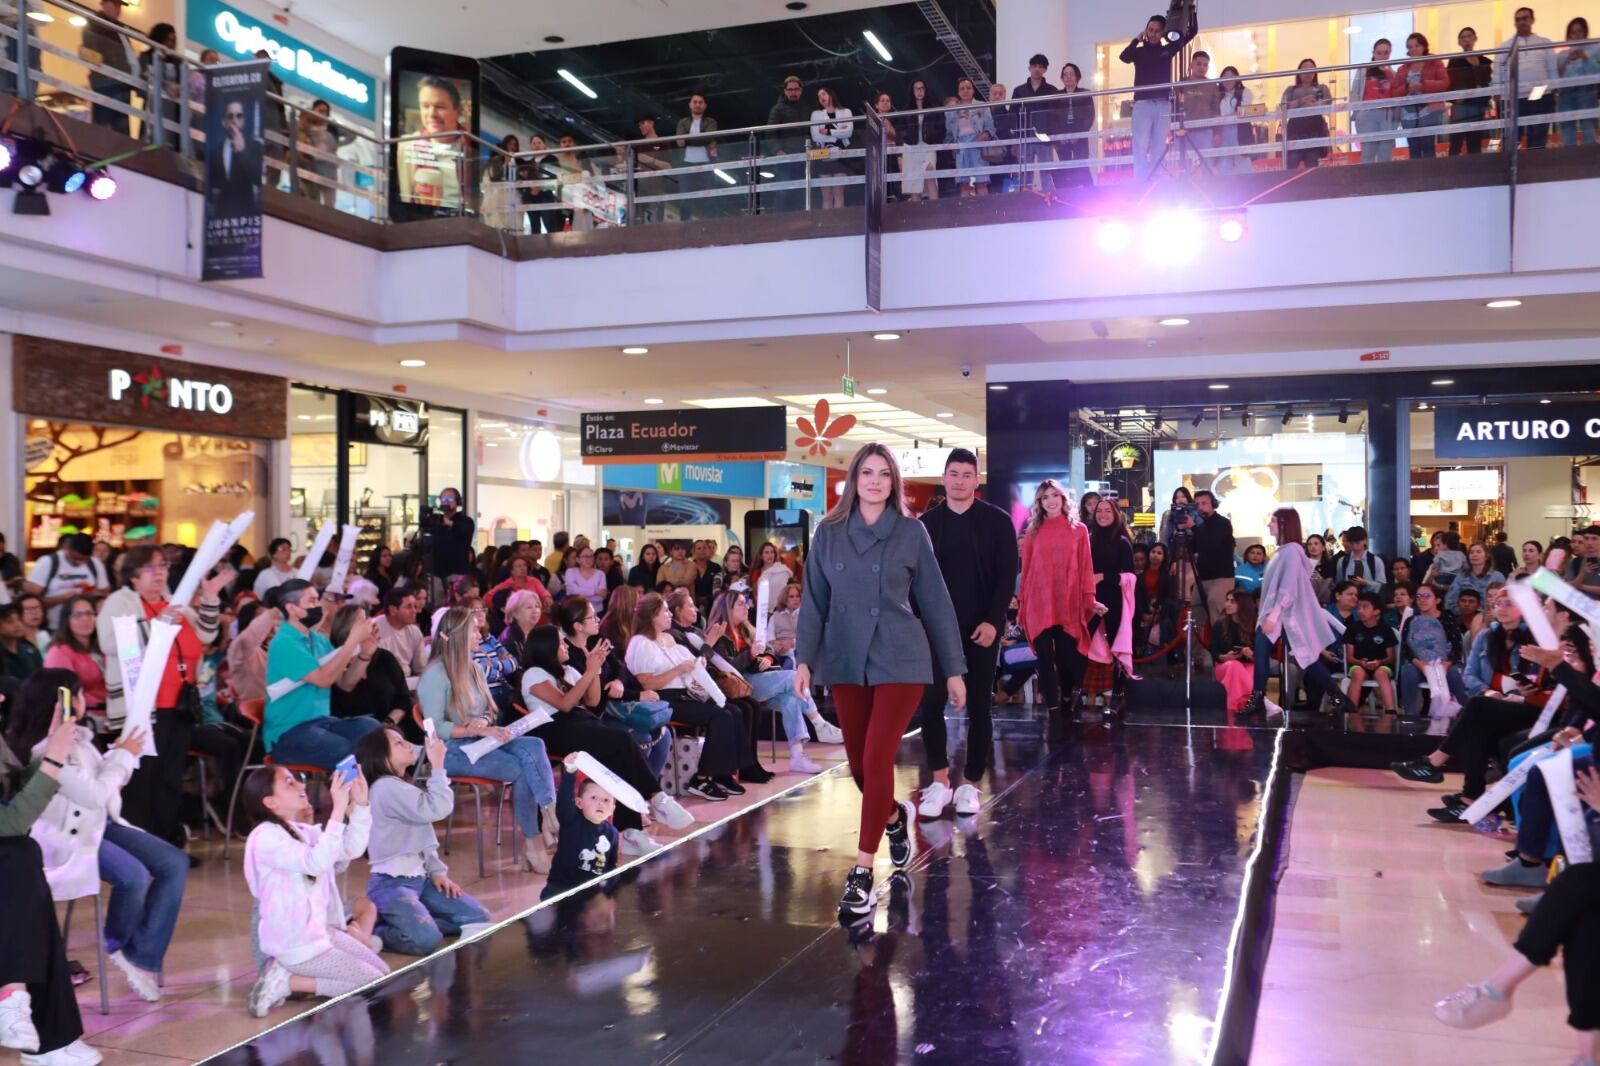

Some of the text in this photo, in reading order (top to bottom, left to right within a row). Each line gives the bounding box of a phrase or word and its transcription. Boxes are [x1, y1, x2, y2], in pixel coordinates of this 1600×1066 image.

[585, 422, 697, 440] Plaza Ecuador
[1456, 418, 1571, 441] ARTURO
[669, 443, 700, 452] Movistar
[684, 463, 723, 484] movistar
